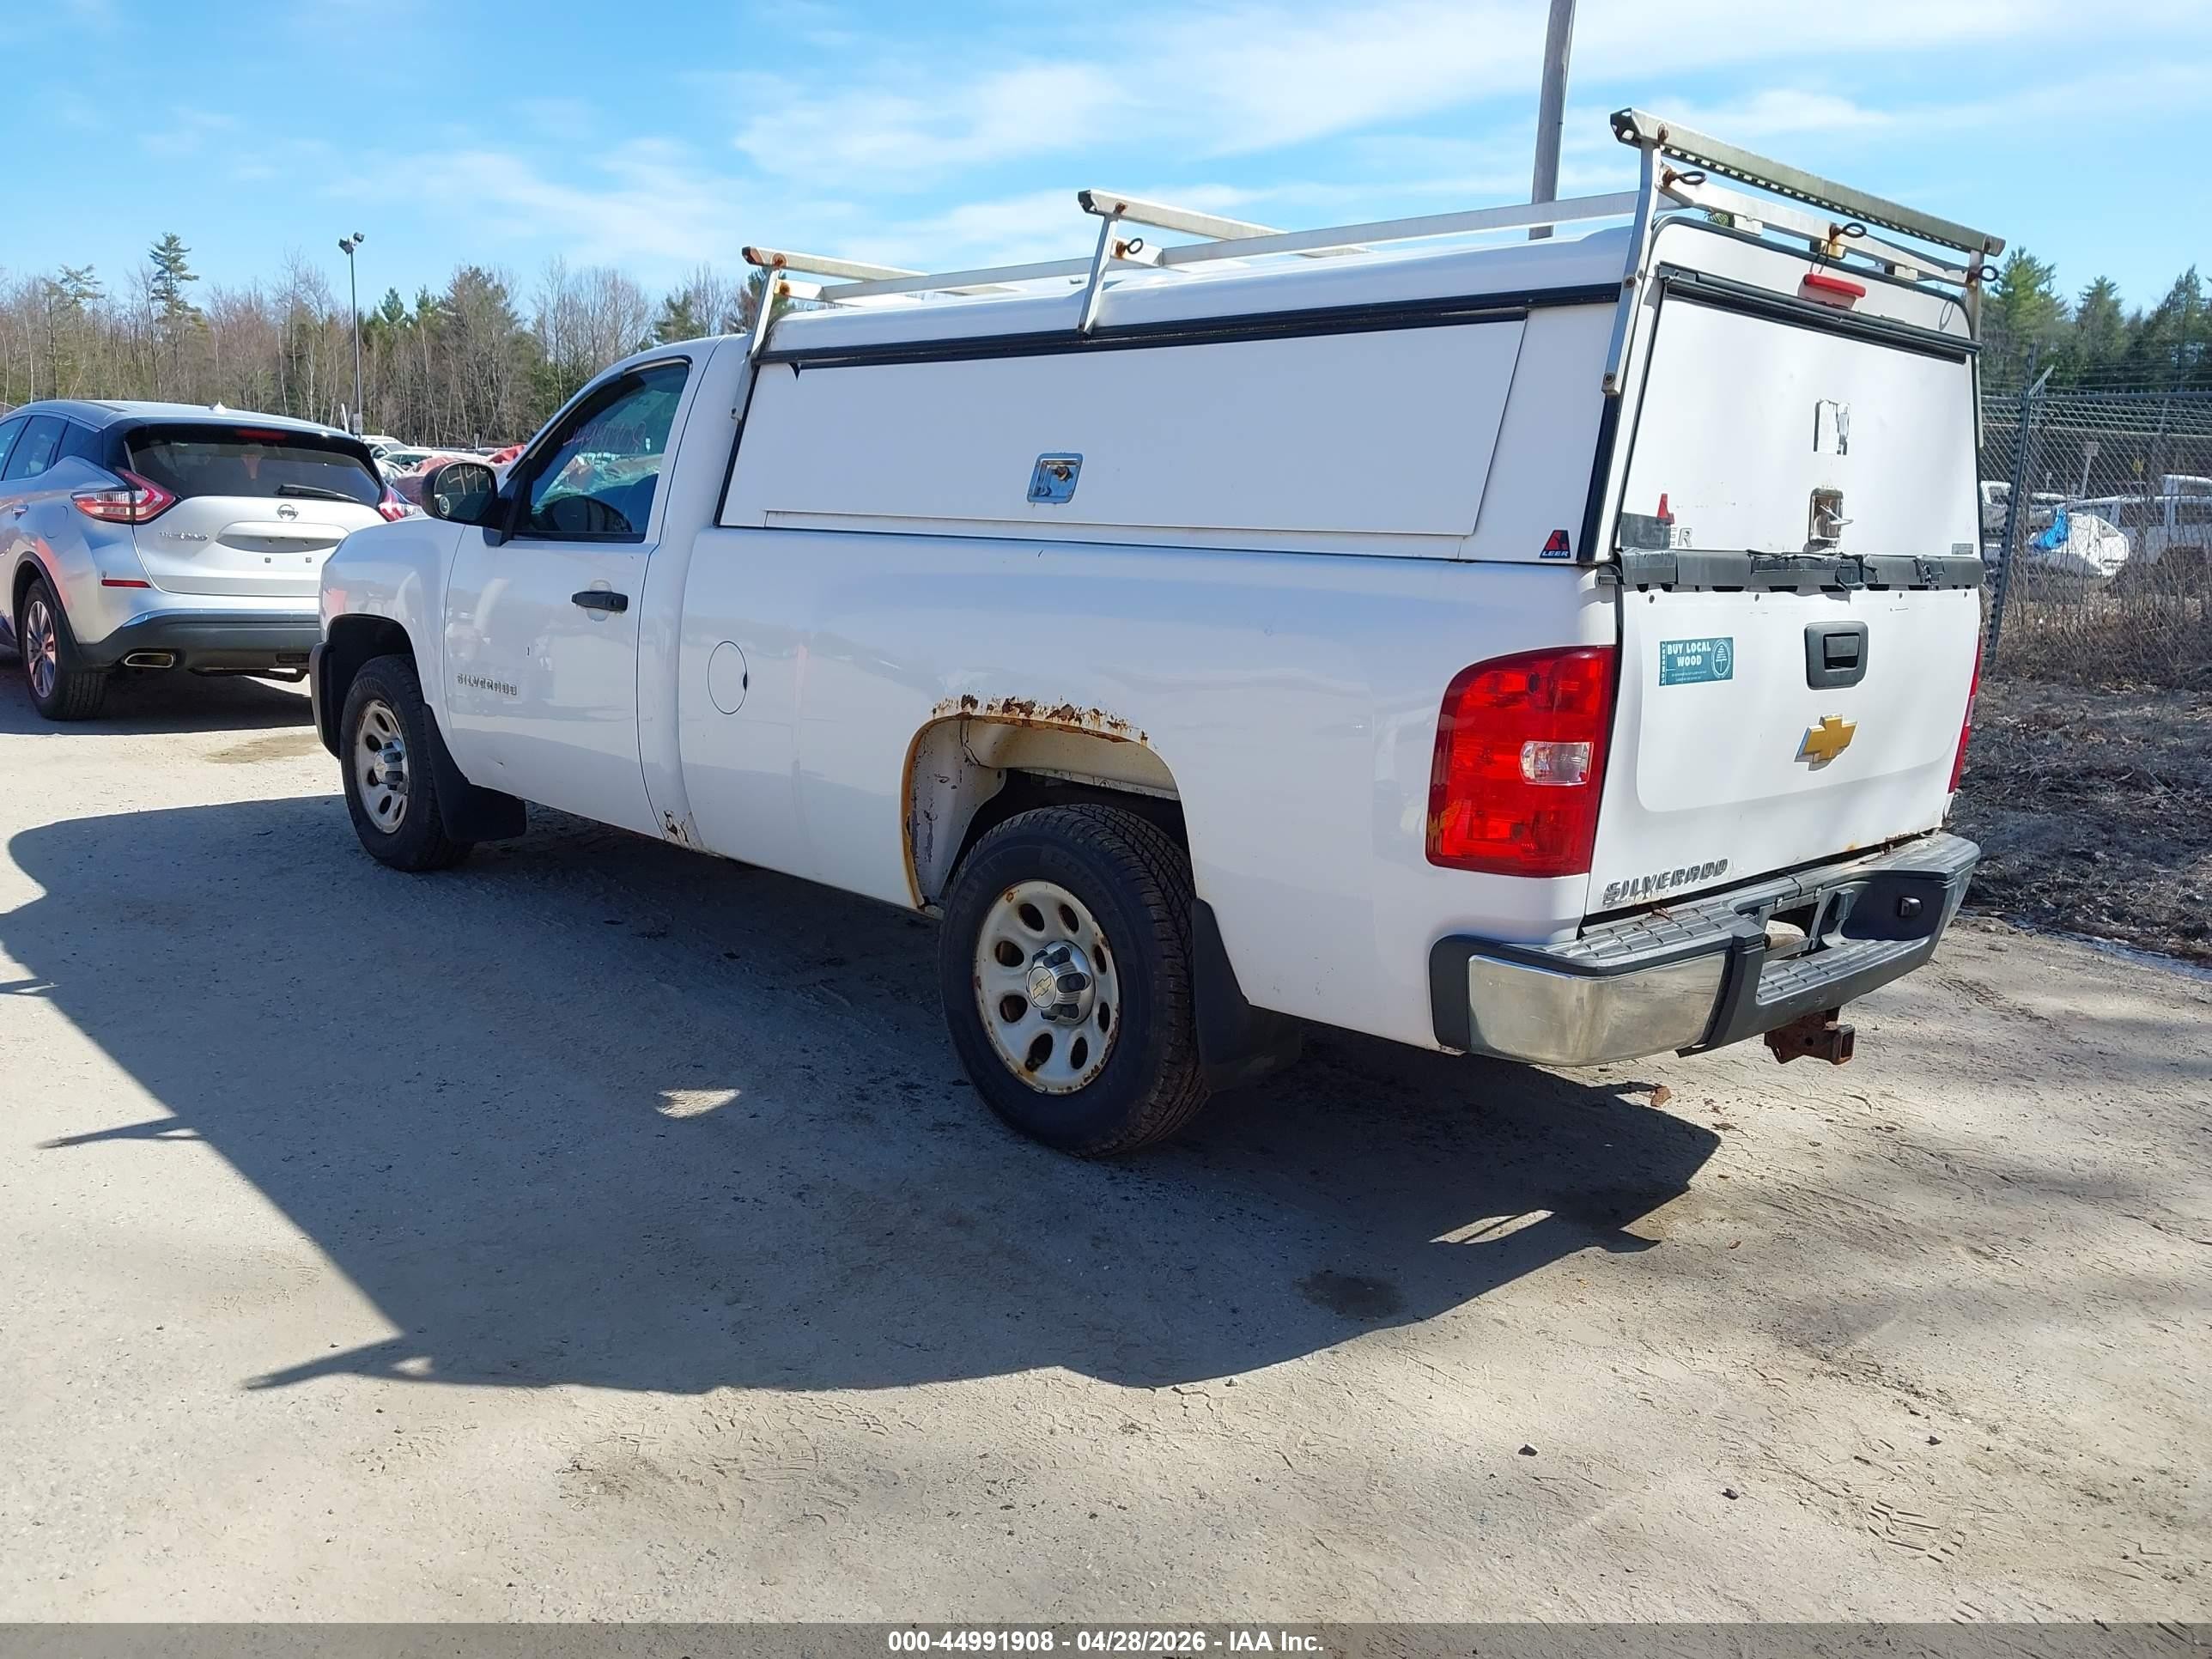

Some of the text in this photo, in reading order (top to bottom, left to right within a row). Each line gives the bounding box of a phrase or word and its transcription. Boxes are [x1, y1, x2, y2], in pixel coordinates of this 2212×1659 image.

[1542, 550, 1570, 558] LEER
[1667, 641, 1711, 655] BUY LOCAL
[1677, 654, 1702, 667] WOOD
[457, 672, 518, 696] SILVERADO
[1602, 859, 1729, 902] SILVERADO
